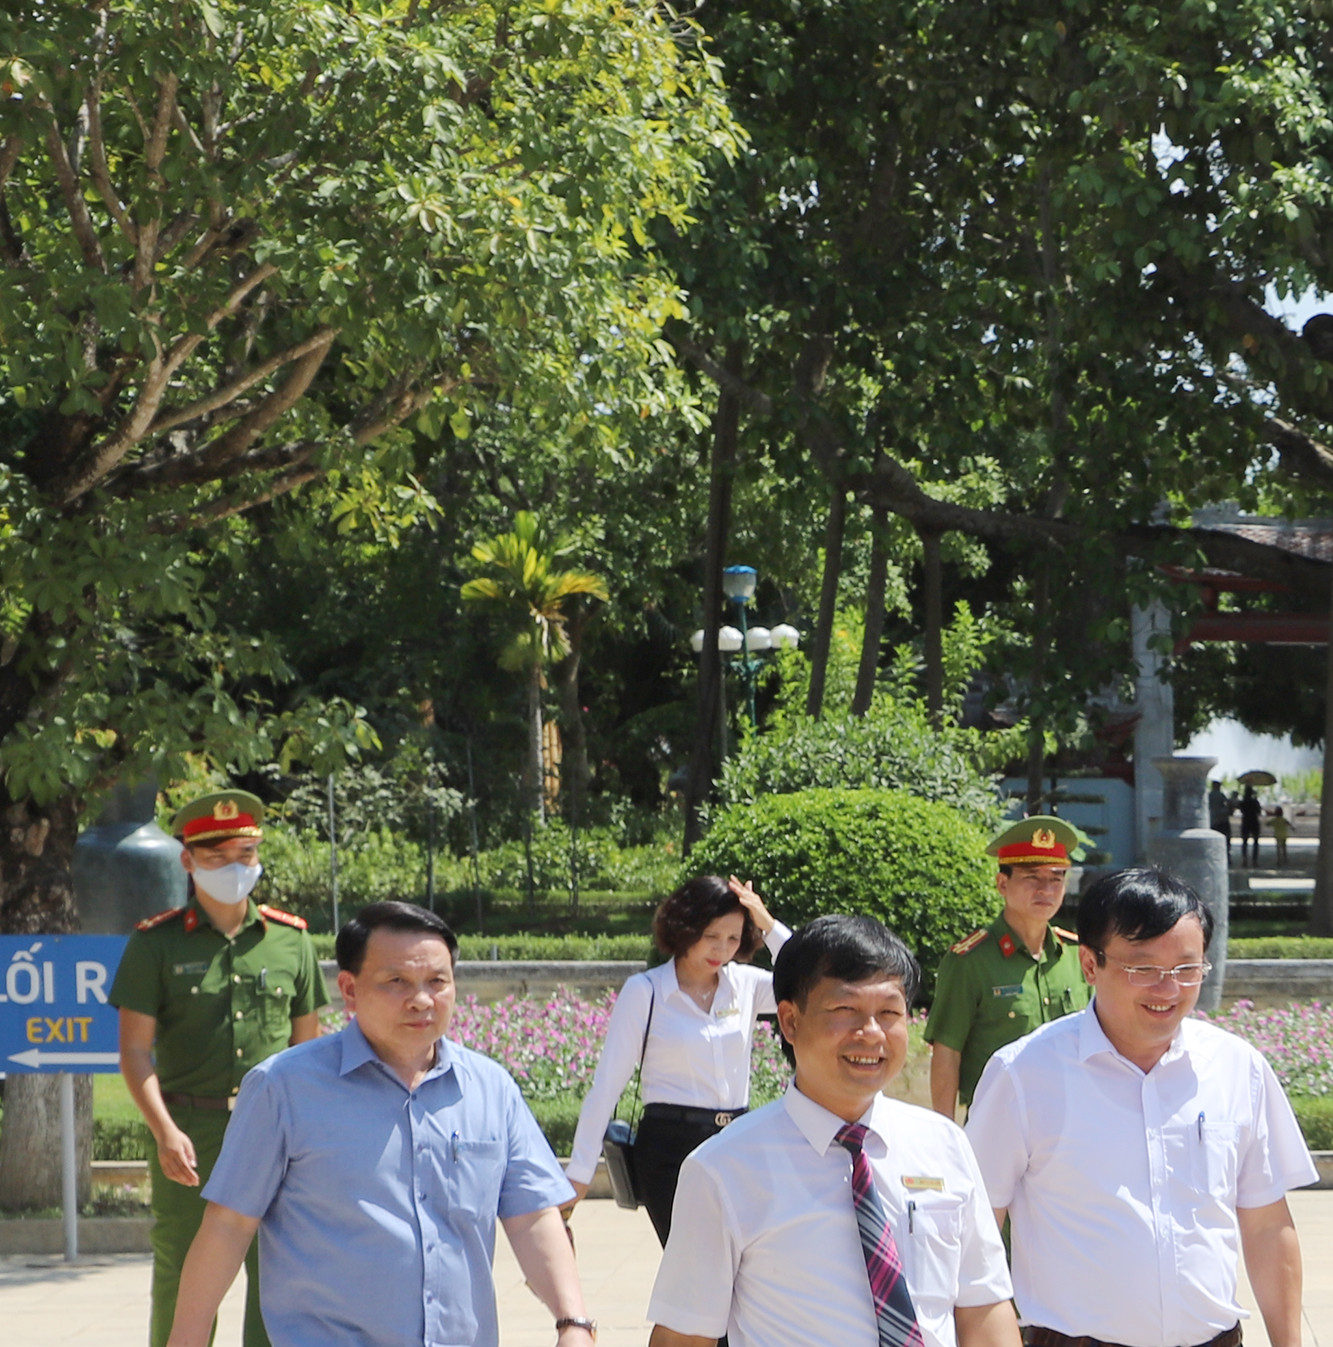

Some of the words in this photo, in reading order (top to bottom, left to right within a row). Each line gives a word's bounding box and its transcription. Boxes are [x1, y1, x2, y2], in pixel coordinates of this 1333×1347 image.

[0, 942, 54, 1005] ỐI
[75, 961, 108, 1005] R
[26, 1017, 93, 1043] EXIT
